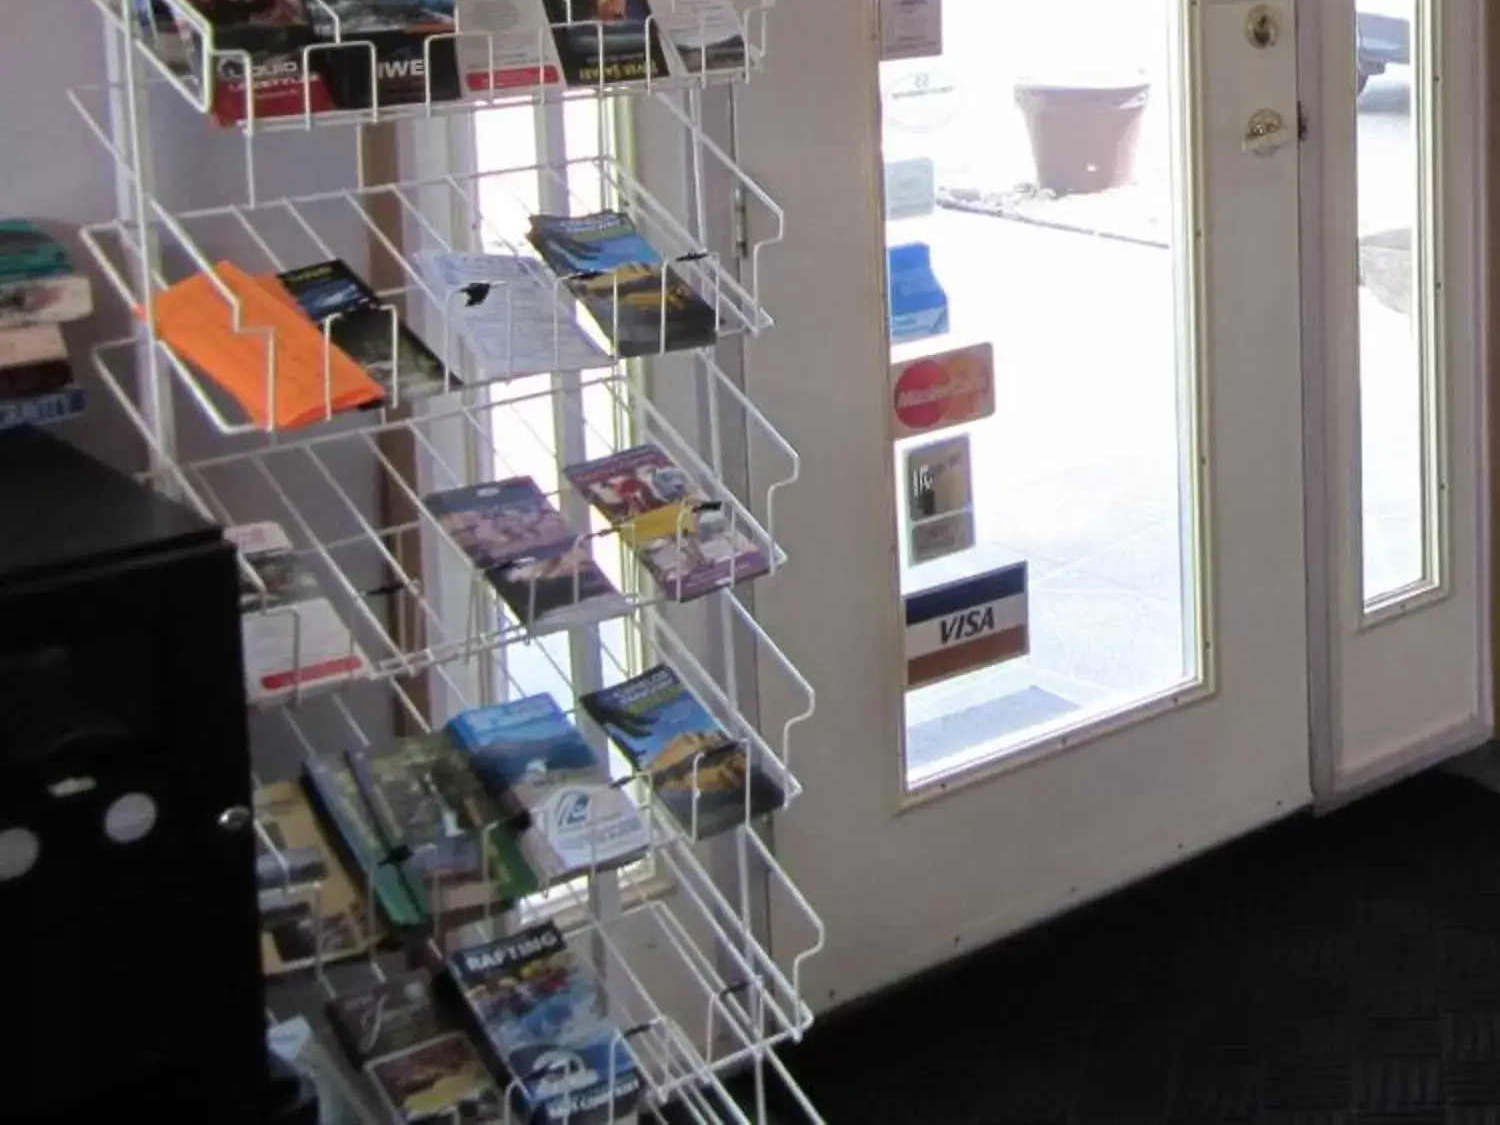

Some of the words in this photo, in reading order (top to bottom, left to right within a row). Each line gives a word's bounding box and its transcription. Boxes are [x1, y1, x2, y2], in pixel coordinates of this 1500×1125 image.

[378, 58, 426, 79] IWE
[938, 606, 997, 644] VISA
[465, 932, 559, 973] RAFTING
